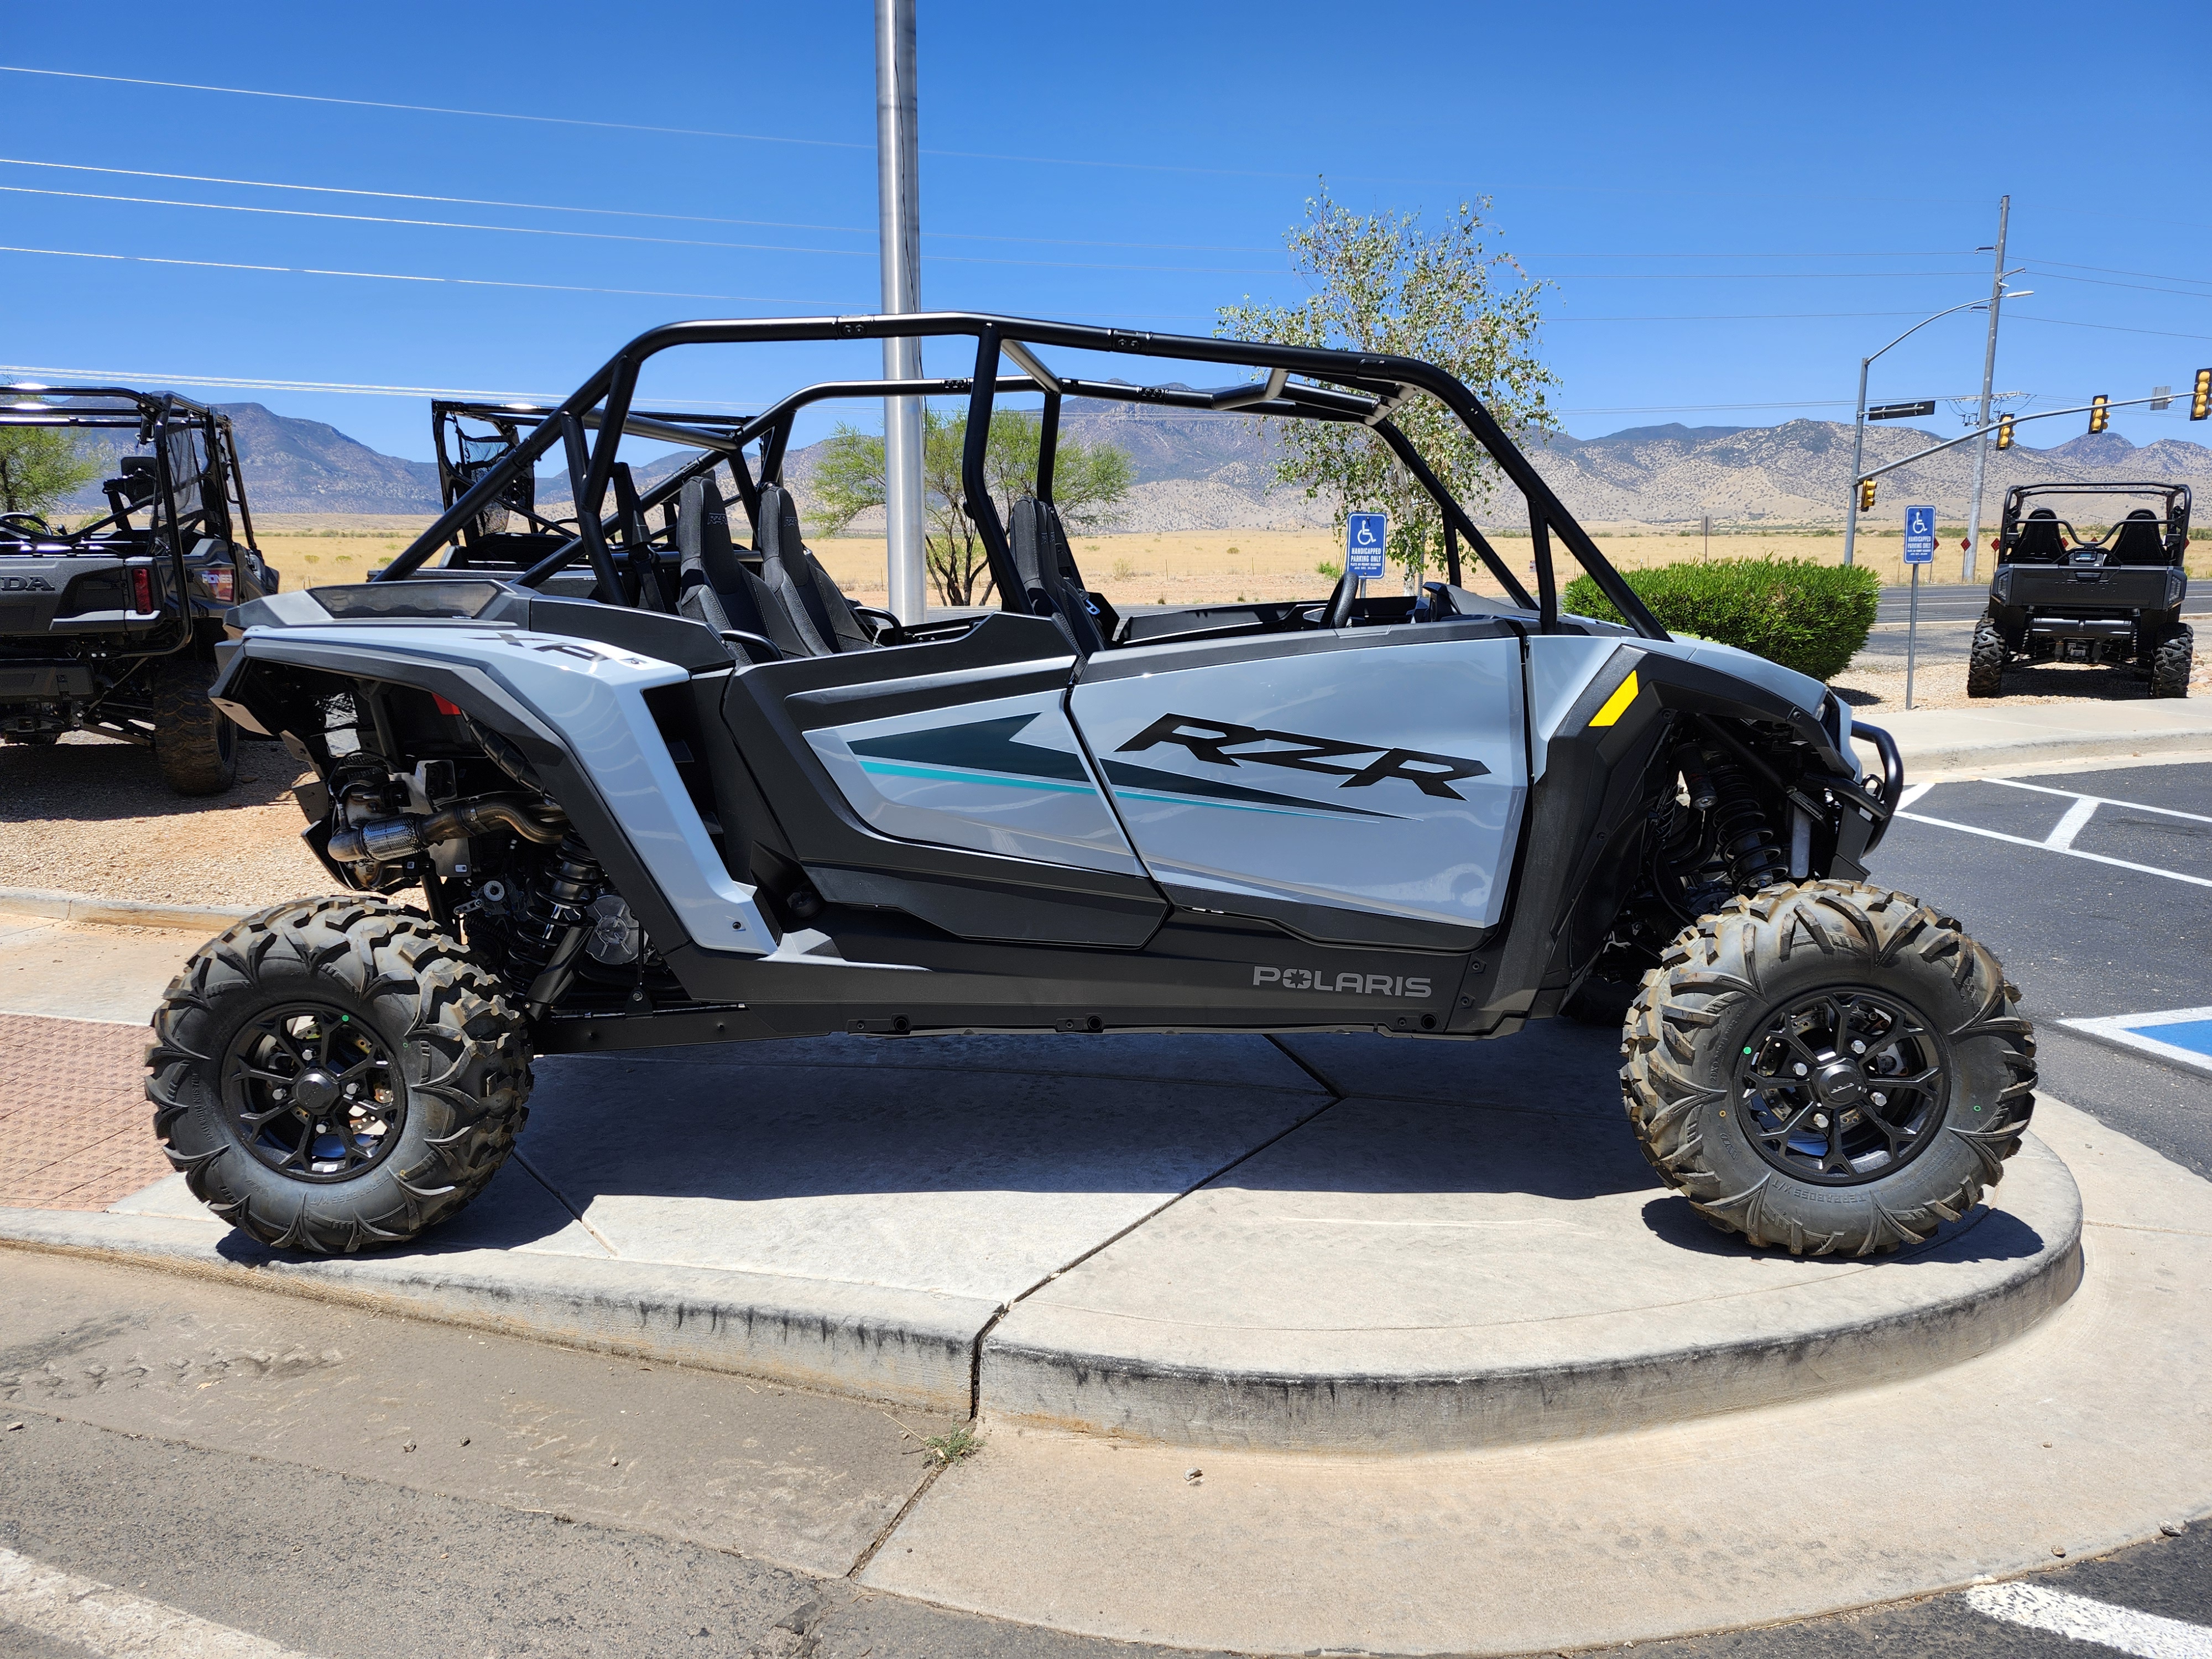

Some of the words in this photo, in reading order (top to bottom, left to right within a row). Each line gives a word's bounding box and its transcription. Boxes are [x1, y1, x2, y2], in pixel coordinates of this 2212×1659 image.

[707, 513, 728, 525] RZR
[1112, 712, 1493, 802] RZR
[1253, 966, 1432, 998] POLARIS
